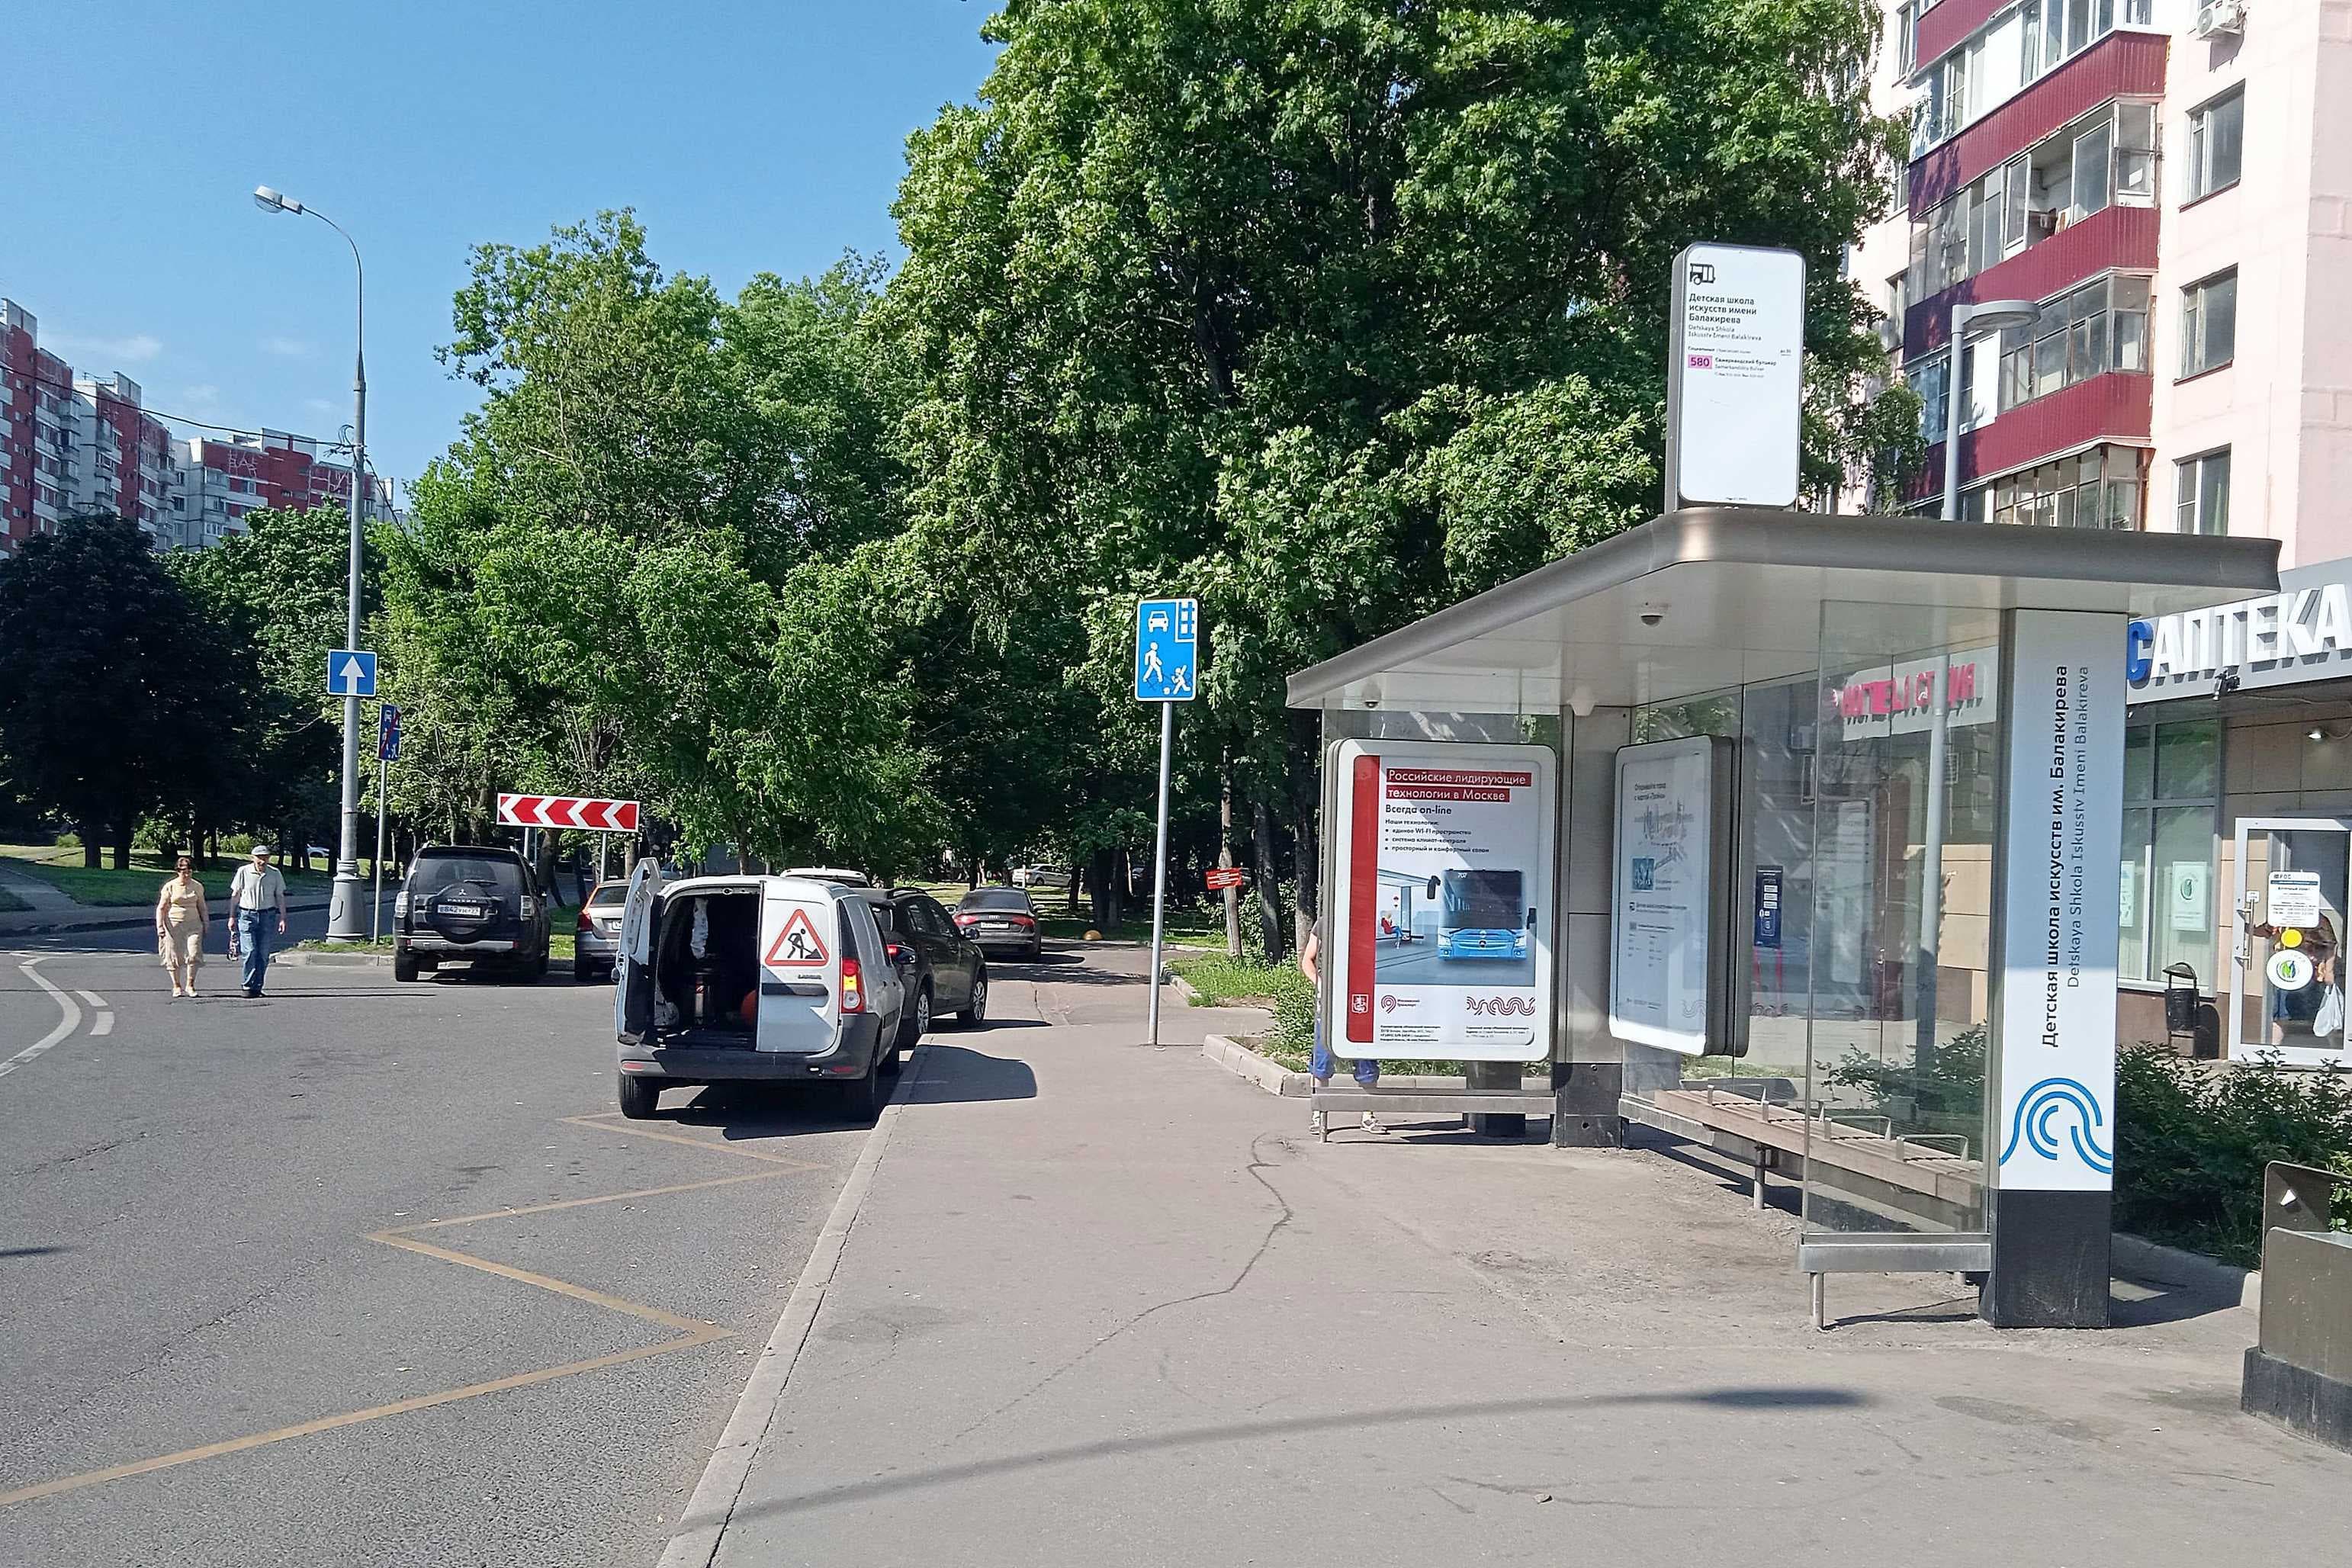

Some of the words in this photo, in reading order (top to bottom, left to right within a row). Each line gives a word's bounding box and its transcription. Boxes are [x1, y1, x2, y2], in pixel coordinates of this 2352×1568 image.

[1688, 293, 1724, 304] Детская
[1727, 296, 1755, 305] школа
[1688, 304, 1727, 313] искусств
[1728, 307, 1757, 315] имени
[1688, 313, 1741, 324] Балакирева
[1689, 356, 1710, 367] 580
[2150, 584, 2352, 679] АПТЕКА
[2049, 666, 2069, 779] Балакирева
[2074, 666, 2089, 744] Balakireva
[1387, 789, 1451, 799] технологии
[1462, 789, 1505, 801] Москве
[1388, 770, 1452, 782] Российские
[1454, 773, 1526, 786] лидирующие
[2073, 750, 2086, 795] Imeni
[1385, 804, 1418, 815] Всегда
[1419, 805, 1452, 815] on-line
[2052, 784, 2064, 816] им.
[2049, 821, 2064, 901] искусств
[2069, 866, 2083, 916] Shkola
[2047, 907, 2060, 966] школа
[2068, 920, 2084, 988] Detskaya
[2042, 971, 2059, 1048] Детская
